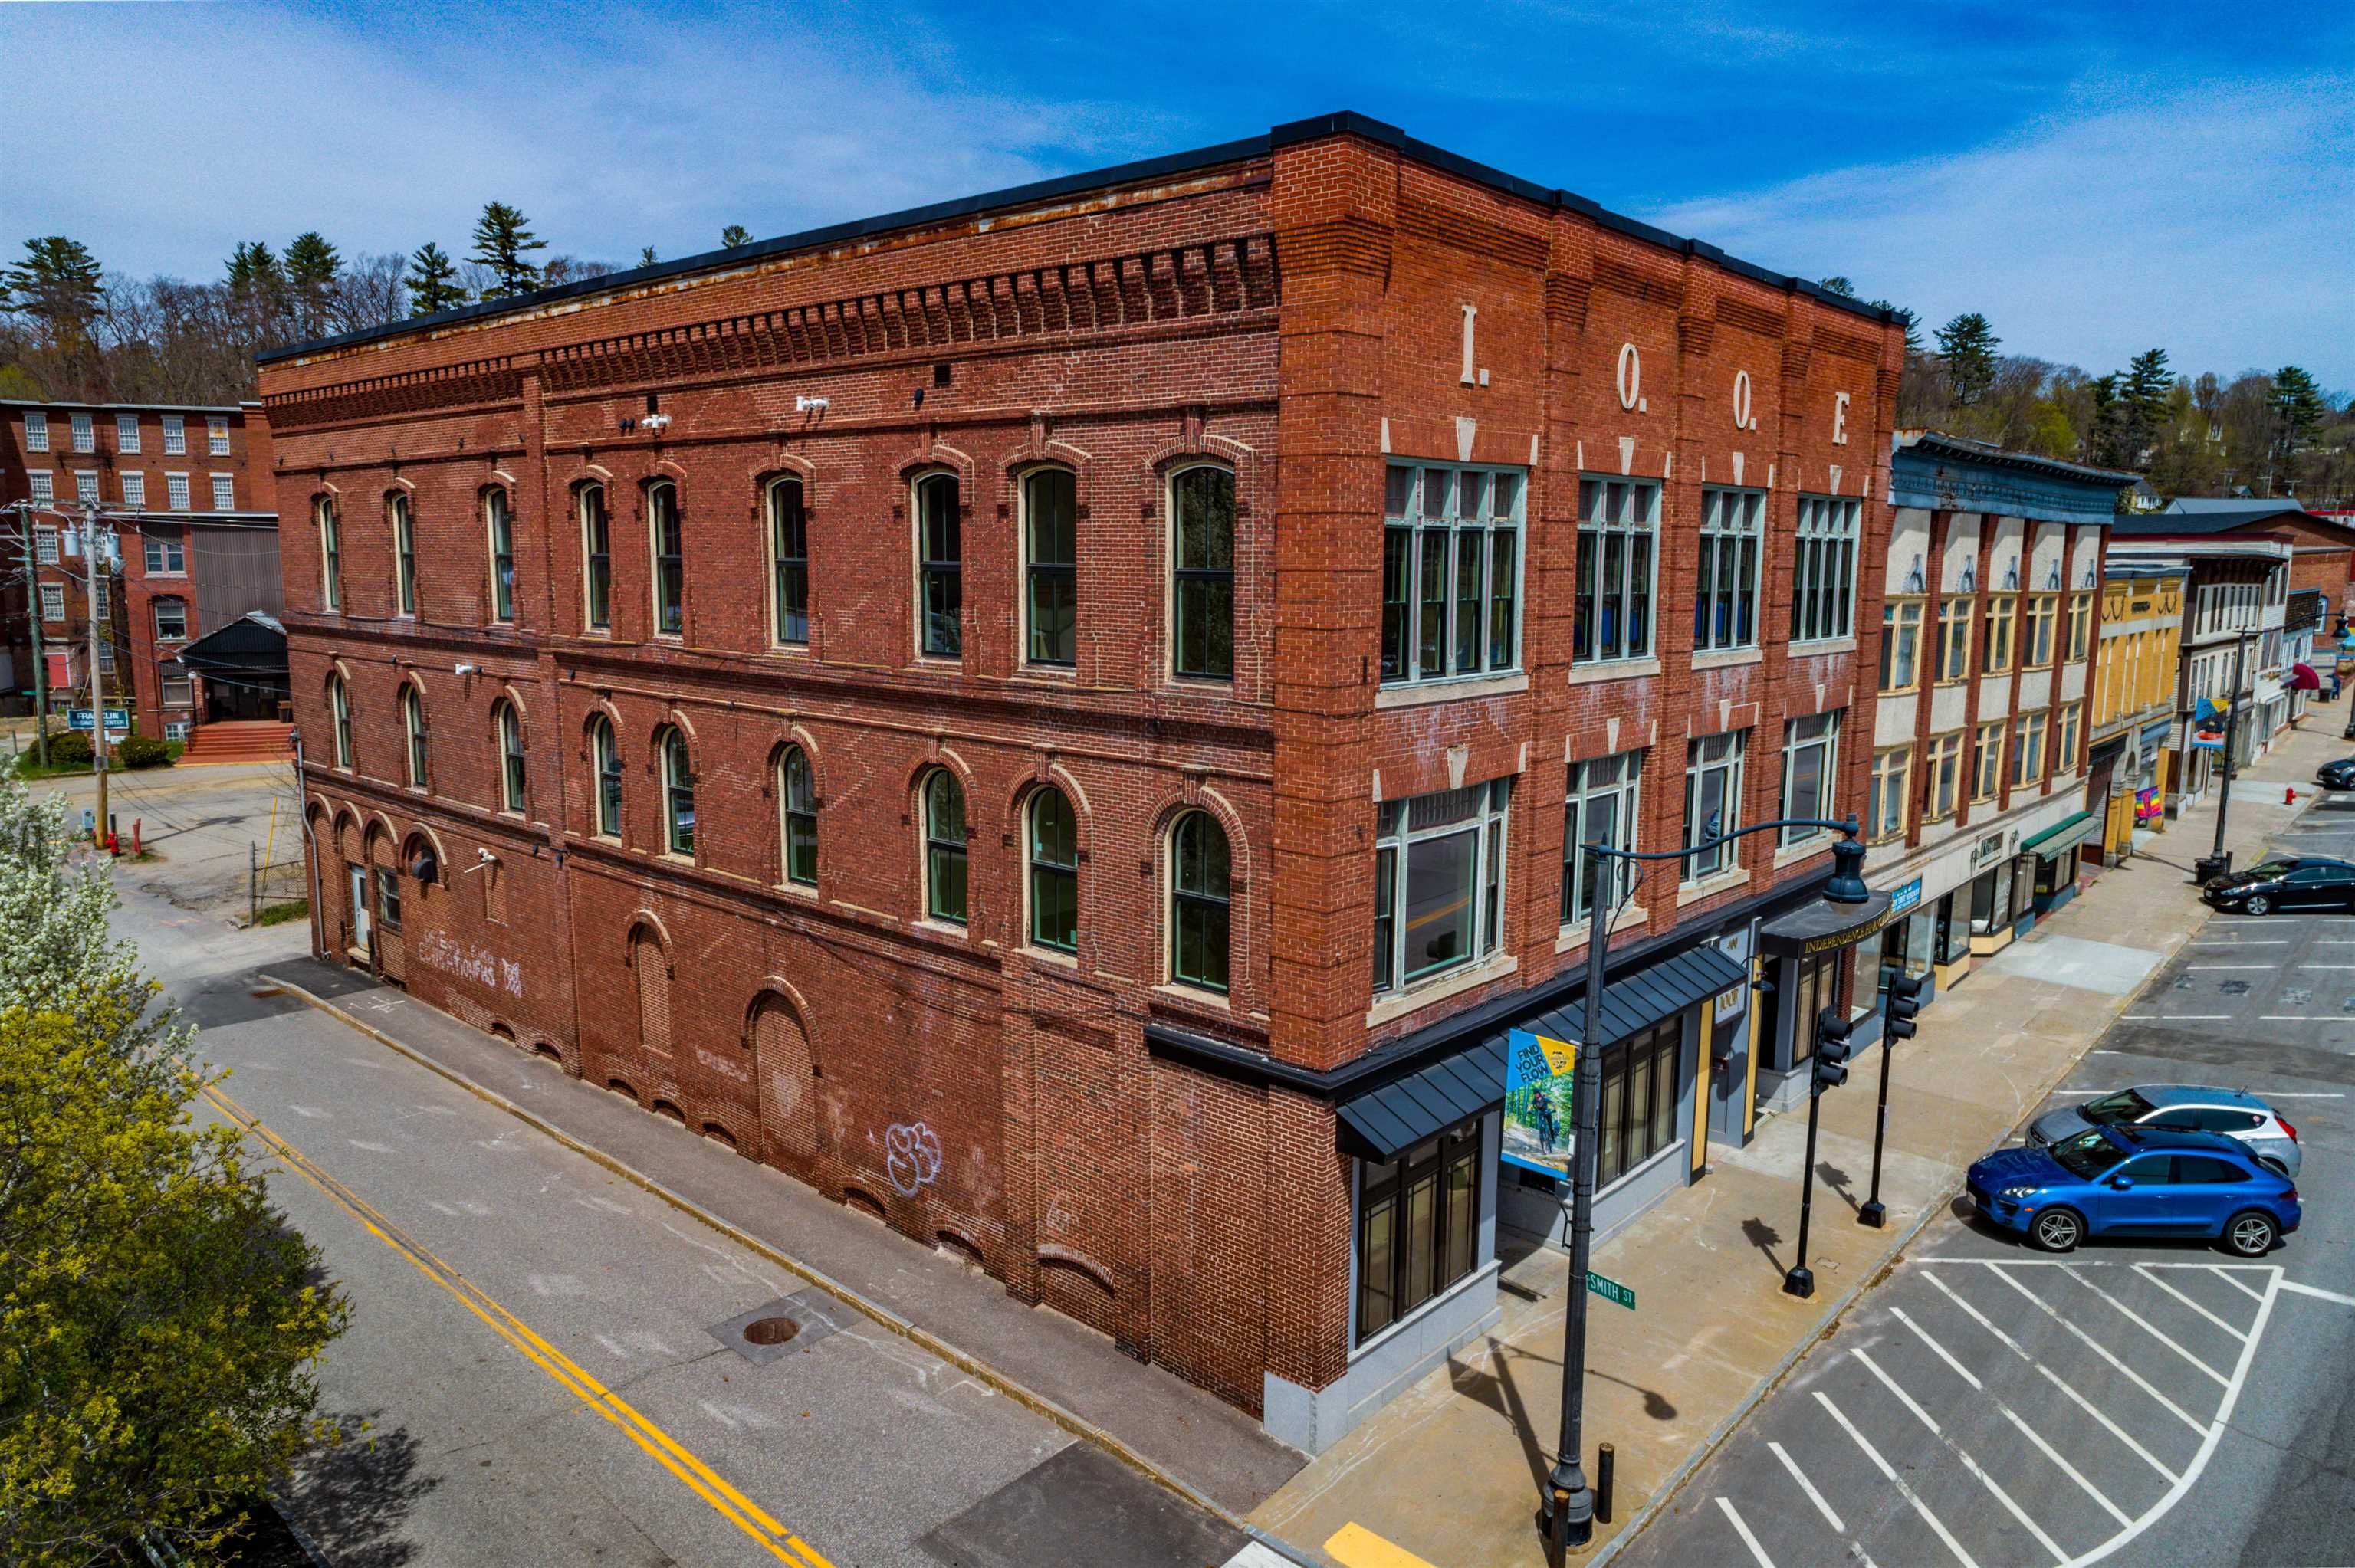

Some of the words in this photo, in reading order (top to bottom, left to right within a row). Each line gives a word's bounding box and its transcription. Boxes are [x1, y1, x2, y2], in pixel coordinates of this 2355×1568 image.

[1517, 1044, 1540, 1061] FIND
[1515, 1055, 1543, 1073] YOUR
[1520, 1063, 1549, 1084] FLOW
[1590, 1274, 1619, 1301] SMITH
[1623, 1289, 1632, 1304] ST
